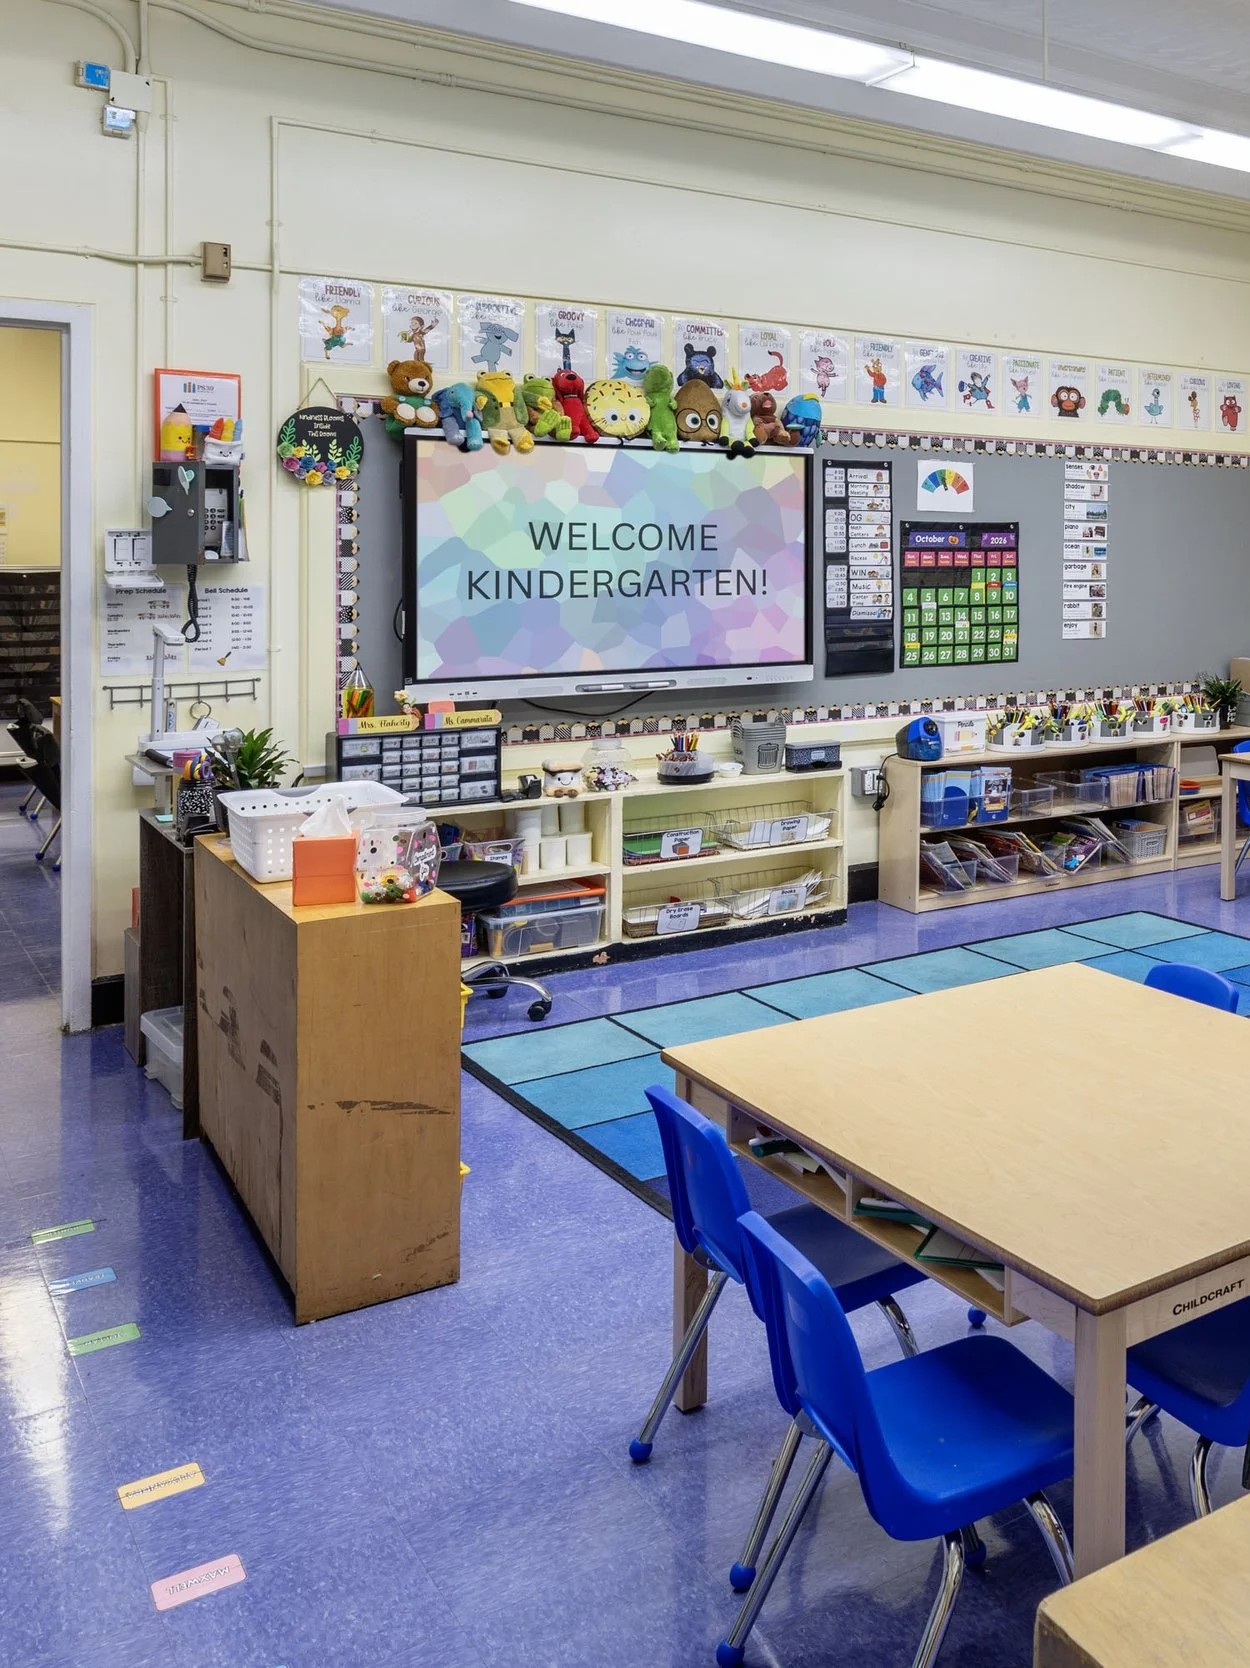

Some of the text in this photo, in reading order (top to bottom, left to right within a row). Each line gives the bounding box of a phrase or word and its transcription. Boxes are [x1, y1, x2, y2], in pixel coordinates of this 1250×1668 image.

[325, 284, 361, 299] FRIENDLY
[407, 294, 441, 307] CURIOUS
[558, 310, 585, 323] GROOVY
[760, 331, 777, 342] LOYAL
[869, 342, 893, 354] FRIENDLY
[969, 353, 992, 365] CREATIVE
[848, 472, 869, 480] Arrival
[850, 483, 870, 491] Morning
[1065, 482, 1085, 490] shadow
[850, 489, 869, 497] Meeting
[1065, 503, 1076, 511] city
[850, 513, 863, 522] OG
[1064, 523, 1079, 531] piano
[528, 521, 718, 551] WELCOME
[915, 534, 1008, 545] October 2026
[850, 541, 867, 549] Lunch
[1064, 563, 1087, 571] garbage
[850, 568, 867, 578] WIN
[976, 572, 1013, 581] 1 2 3
[467, 568, 767, 600] KINDERGARTEN!
[851, 582, 872, 591] Music
[115, 586, 167, 596] Prep Schedule
[204, 585, 248, 594] Bell Schedule
[907, 591, 1014, 602] 4 5 6 7 8 9 10
[907, 610, 1015, 622] 11 12 13 14 15 16 17
[1063, 622, 1078, 630] enjoy
[907, 632, 917, 642] 18
[925, 631, 935, 641] 19
[941, 631, 952, 641] 20
[958, 631, 968, 640] 21
[973, 630, 985, 640] 22
[989, 629, 1000, 639] 23
[905, 647, 1014, 661] 25 26 27 28 29 30 31
[357, 719, 375, 729] Mrs.
[456, 714, 494, 726] Cammarata
[957, 719, 976, 729] Pencils
[780, 818, 801, 828] Drawing
[782, 824, 798, 832] Paper
[666, 829, 700, 838] Construction
[673, 836, 691, 844] Paper
[489, 854, 508, 862] Stamps
[665, 905, 694, 915] Dry Erase
[669, 911, 689, 920] Boards
[1172, 1278, 1245, 1317] CHILDCRAFT
[166, 1566, 230, 1596] MAXWELL
